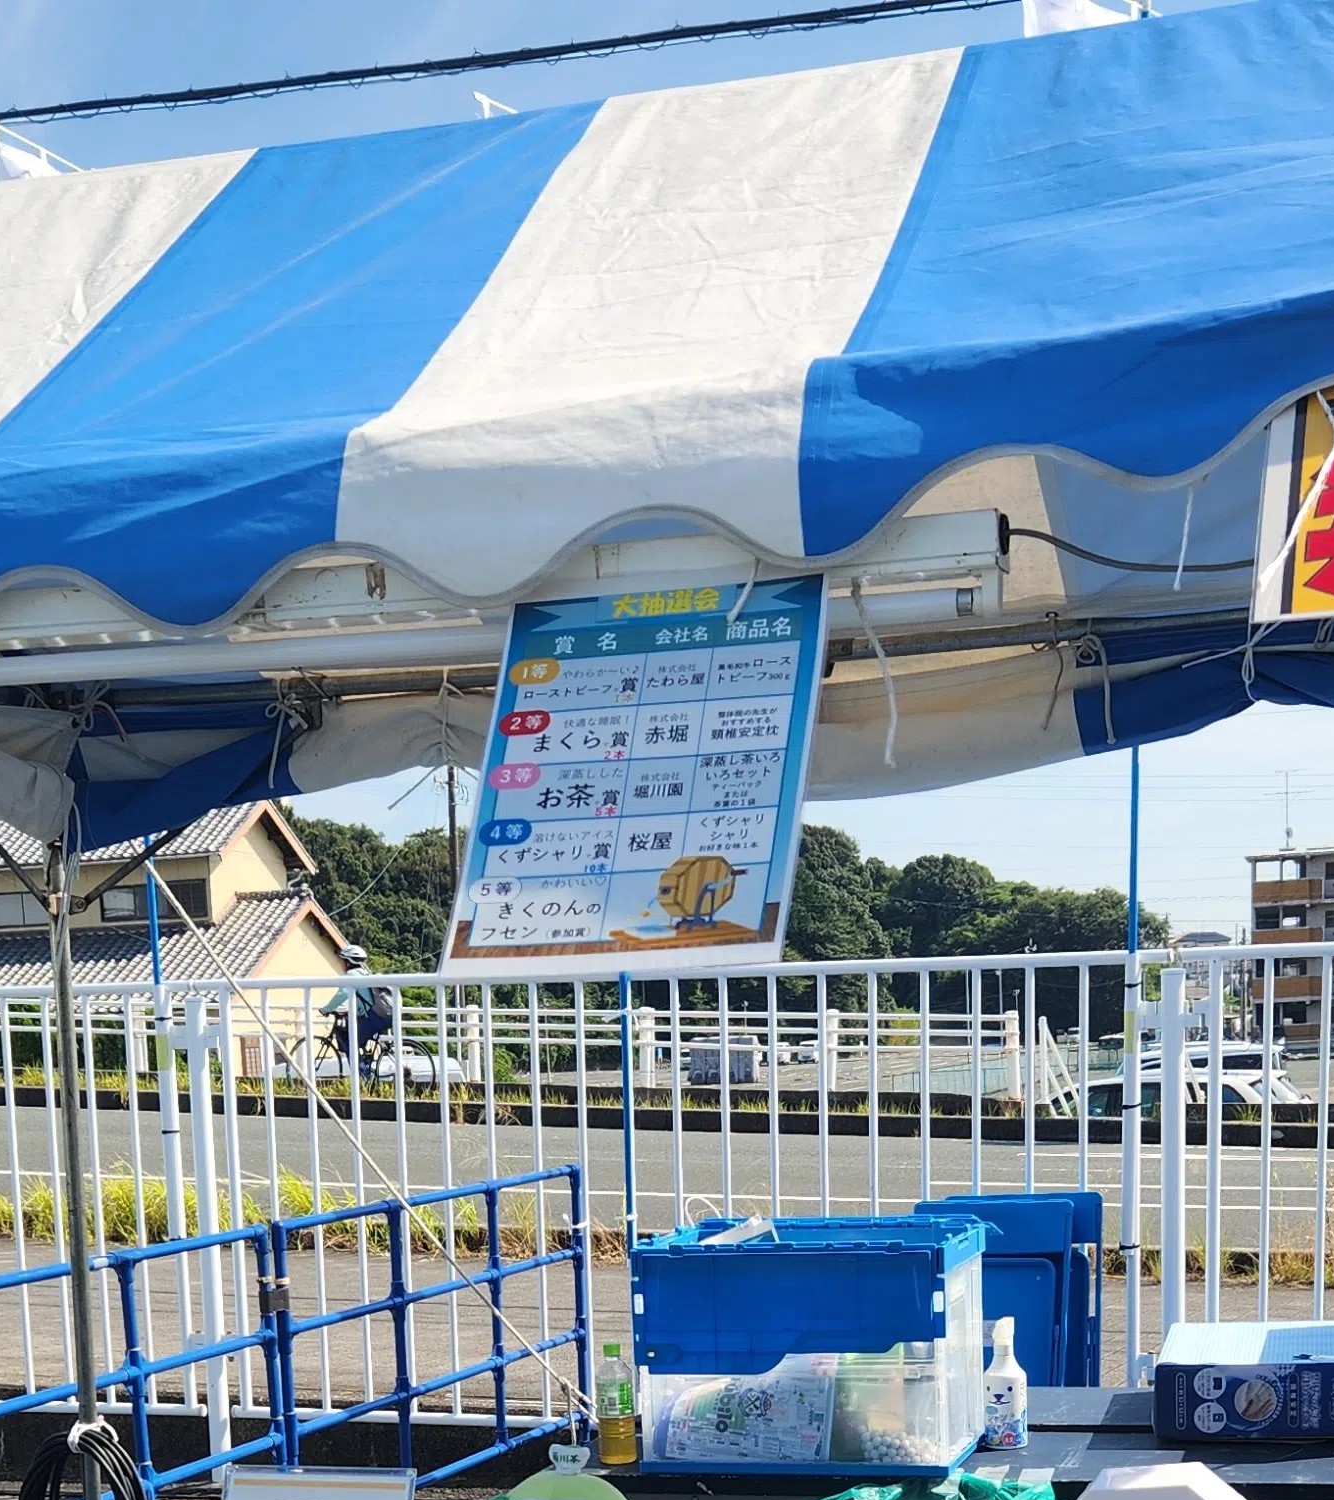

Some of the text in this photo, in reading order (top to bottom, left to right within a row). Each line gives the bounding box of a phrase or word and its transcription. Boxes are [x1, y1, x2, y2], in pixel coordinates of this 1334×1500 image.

[612, 587, 721, 619] 大抽選会
[654, 625, 709, 646] 会社名
[726, 616, 793, 642] 商品名
[521, 662, 549, 681] 1等
[657, 662, 697, 674] 株式会社
[646, 671, 705, 690] たわら屋
[509, 713, 543, 732] 2等
[649, 711, 690, 724] 株式会社
[644, 723, 690, 745] 赤堀
[603, 749, 627, 761] 2本
[698, 751, 782, 769] 深蒸し茶いろ
[499, 766, 533, 785] 3等
[557, 766, 625, 782] 深蒸しした
[640, 770, 681, 784] 株式会社
[705, 766, 772, 782] いろセット
[633, 781, 684, 801] 堀川園
[594, 805, 618, 817] 5本
[700, 812, 766, 829] くずシャリ
[489, 821, 525, 841] 4等
[533, 829, 614, 845] 溶けないアイス
[710, 828, 750, 842] シャリ
[627, 831, 673, 852] 桜屋
[479, 880, 513, 897] 5等
[496, 899, 602, 920] きくのんの
[480, 926, 539, 942] フセン
